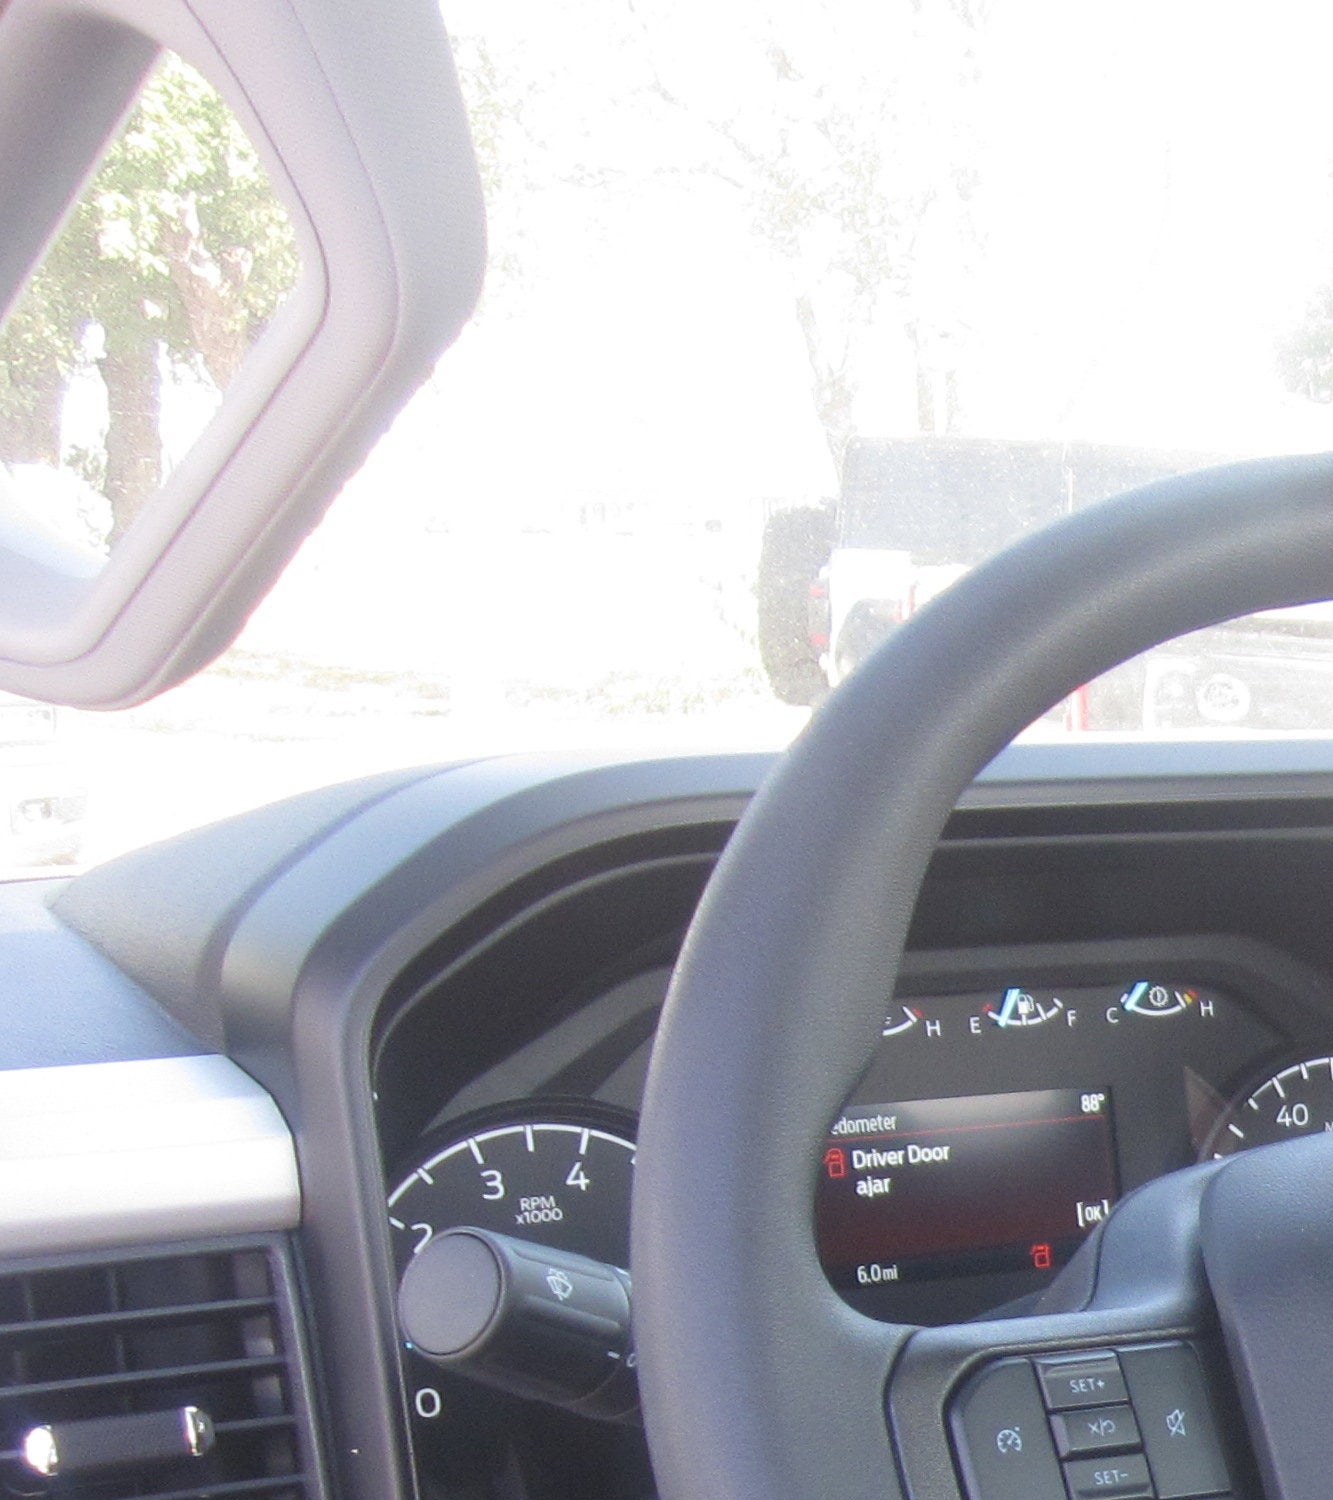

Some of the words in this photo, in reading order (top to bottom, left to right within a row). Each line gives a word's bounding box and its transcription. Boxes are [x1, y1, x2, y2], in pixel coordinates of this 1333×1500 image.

[1066, 1010, 1078, 1027] F
[1106, 1007, 1119, 1024] C
[1200, 1001, 1215, 1018] H
[926, 1019, 942, 1037] H
[970, 1017, 982, 1034] E
[829, 1113, 898, 1136] edometer
[1276, 1103, 1309, 1127] 40
[851, 1147, 905, 1171] Driver
[908, 1143, 951, 1164] Door
[480, 1169, 505, 1200] 3
[565, 1161, 590, 1191] 4
[855, 1176, 892, 1198] ajar
[520, 1194, 556, 1212] RPM
[515, 1207, 563, 1226] x1000
[415, 1388, 441, 1418] 0
